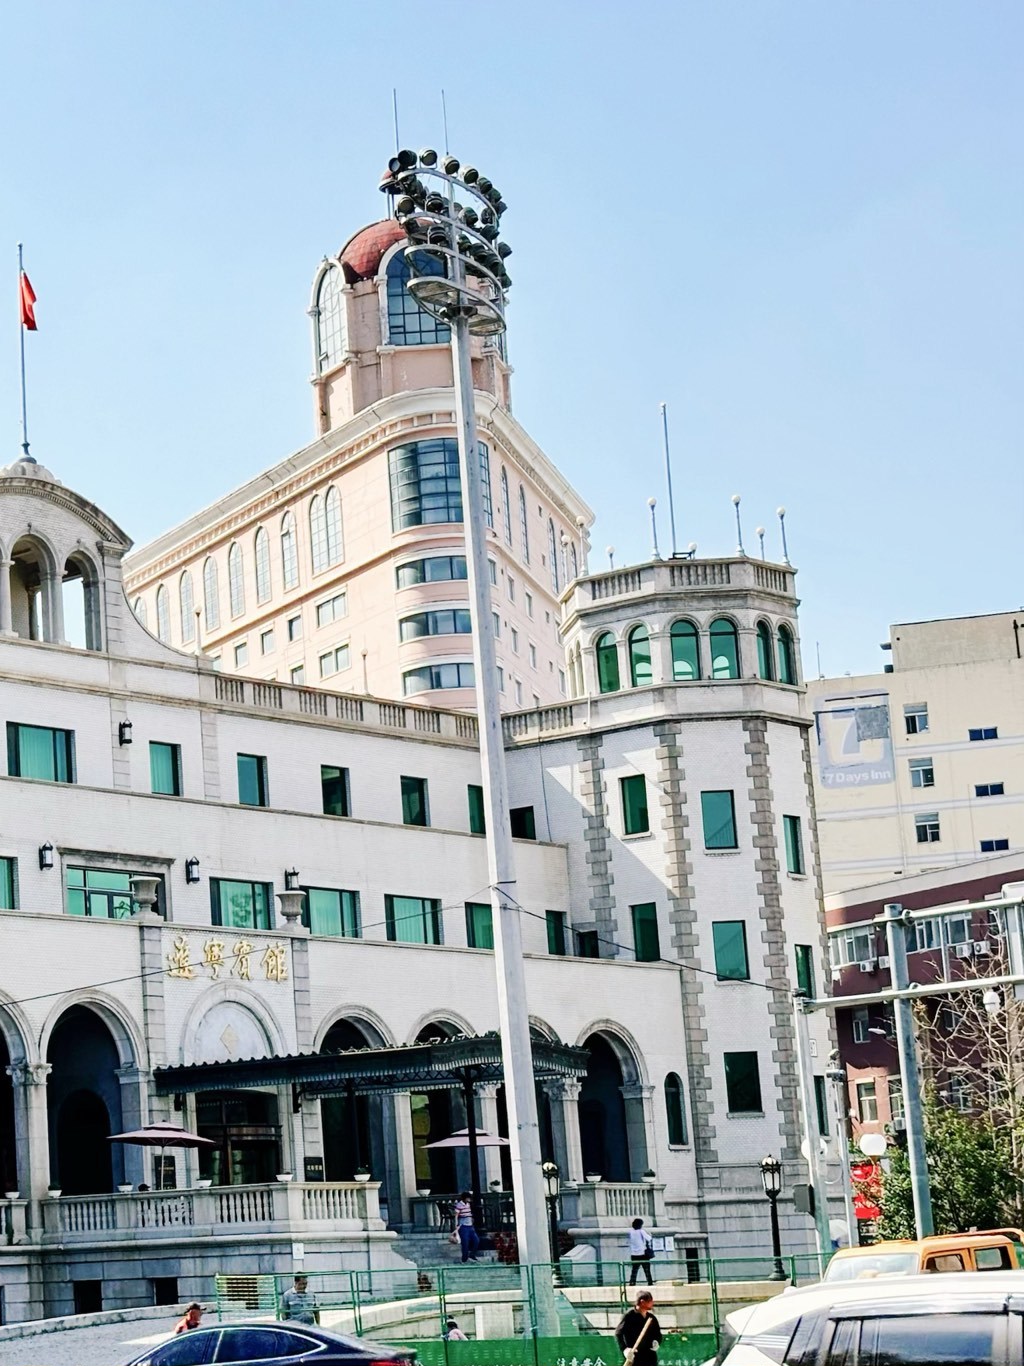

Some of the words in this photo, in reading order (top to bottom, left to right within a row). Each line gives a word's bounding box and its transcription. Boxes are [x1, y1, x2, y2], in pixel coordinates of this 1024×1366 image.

[824, 773, 835, 784] 7
[836, 770, 870, 784] Days
[871, 769, 892, 779] Inn
